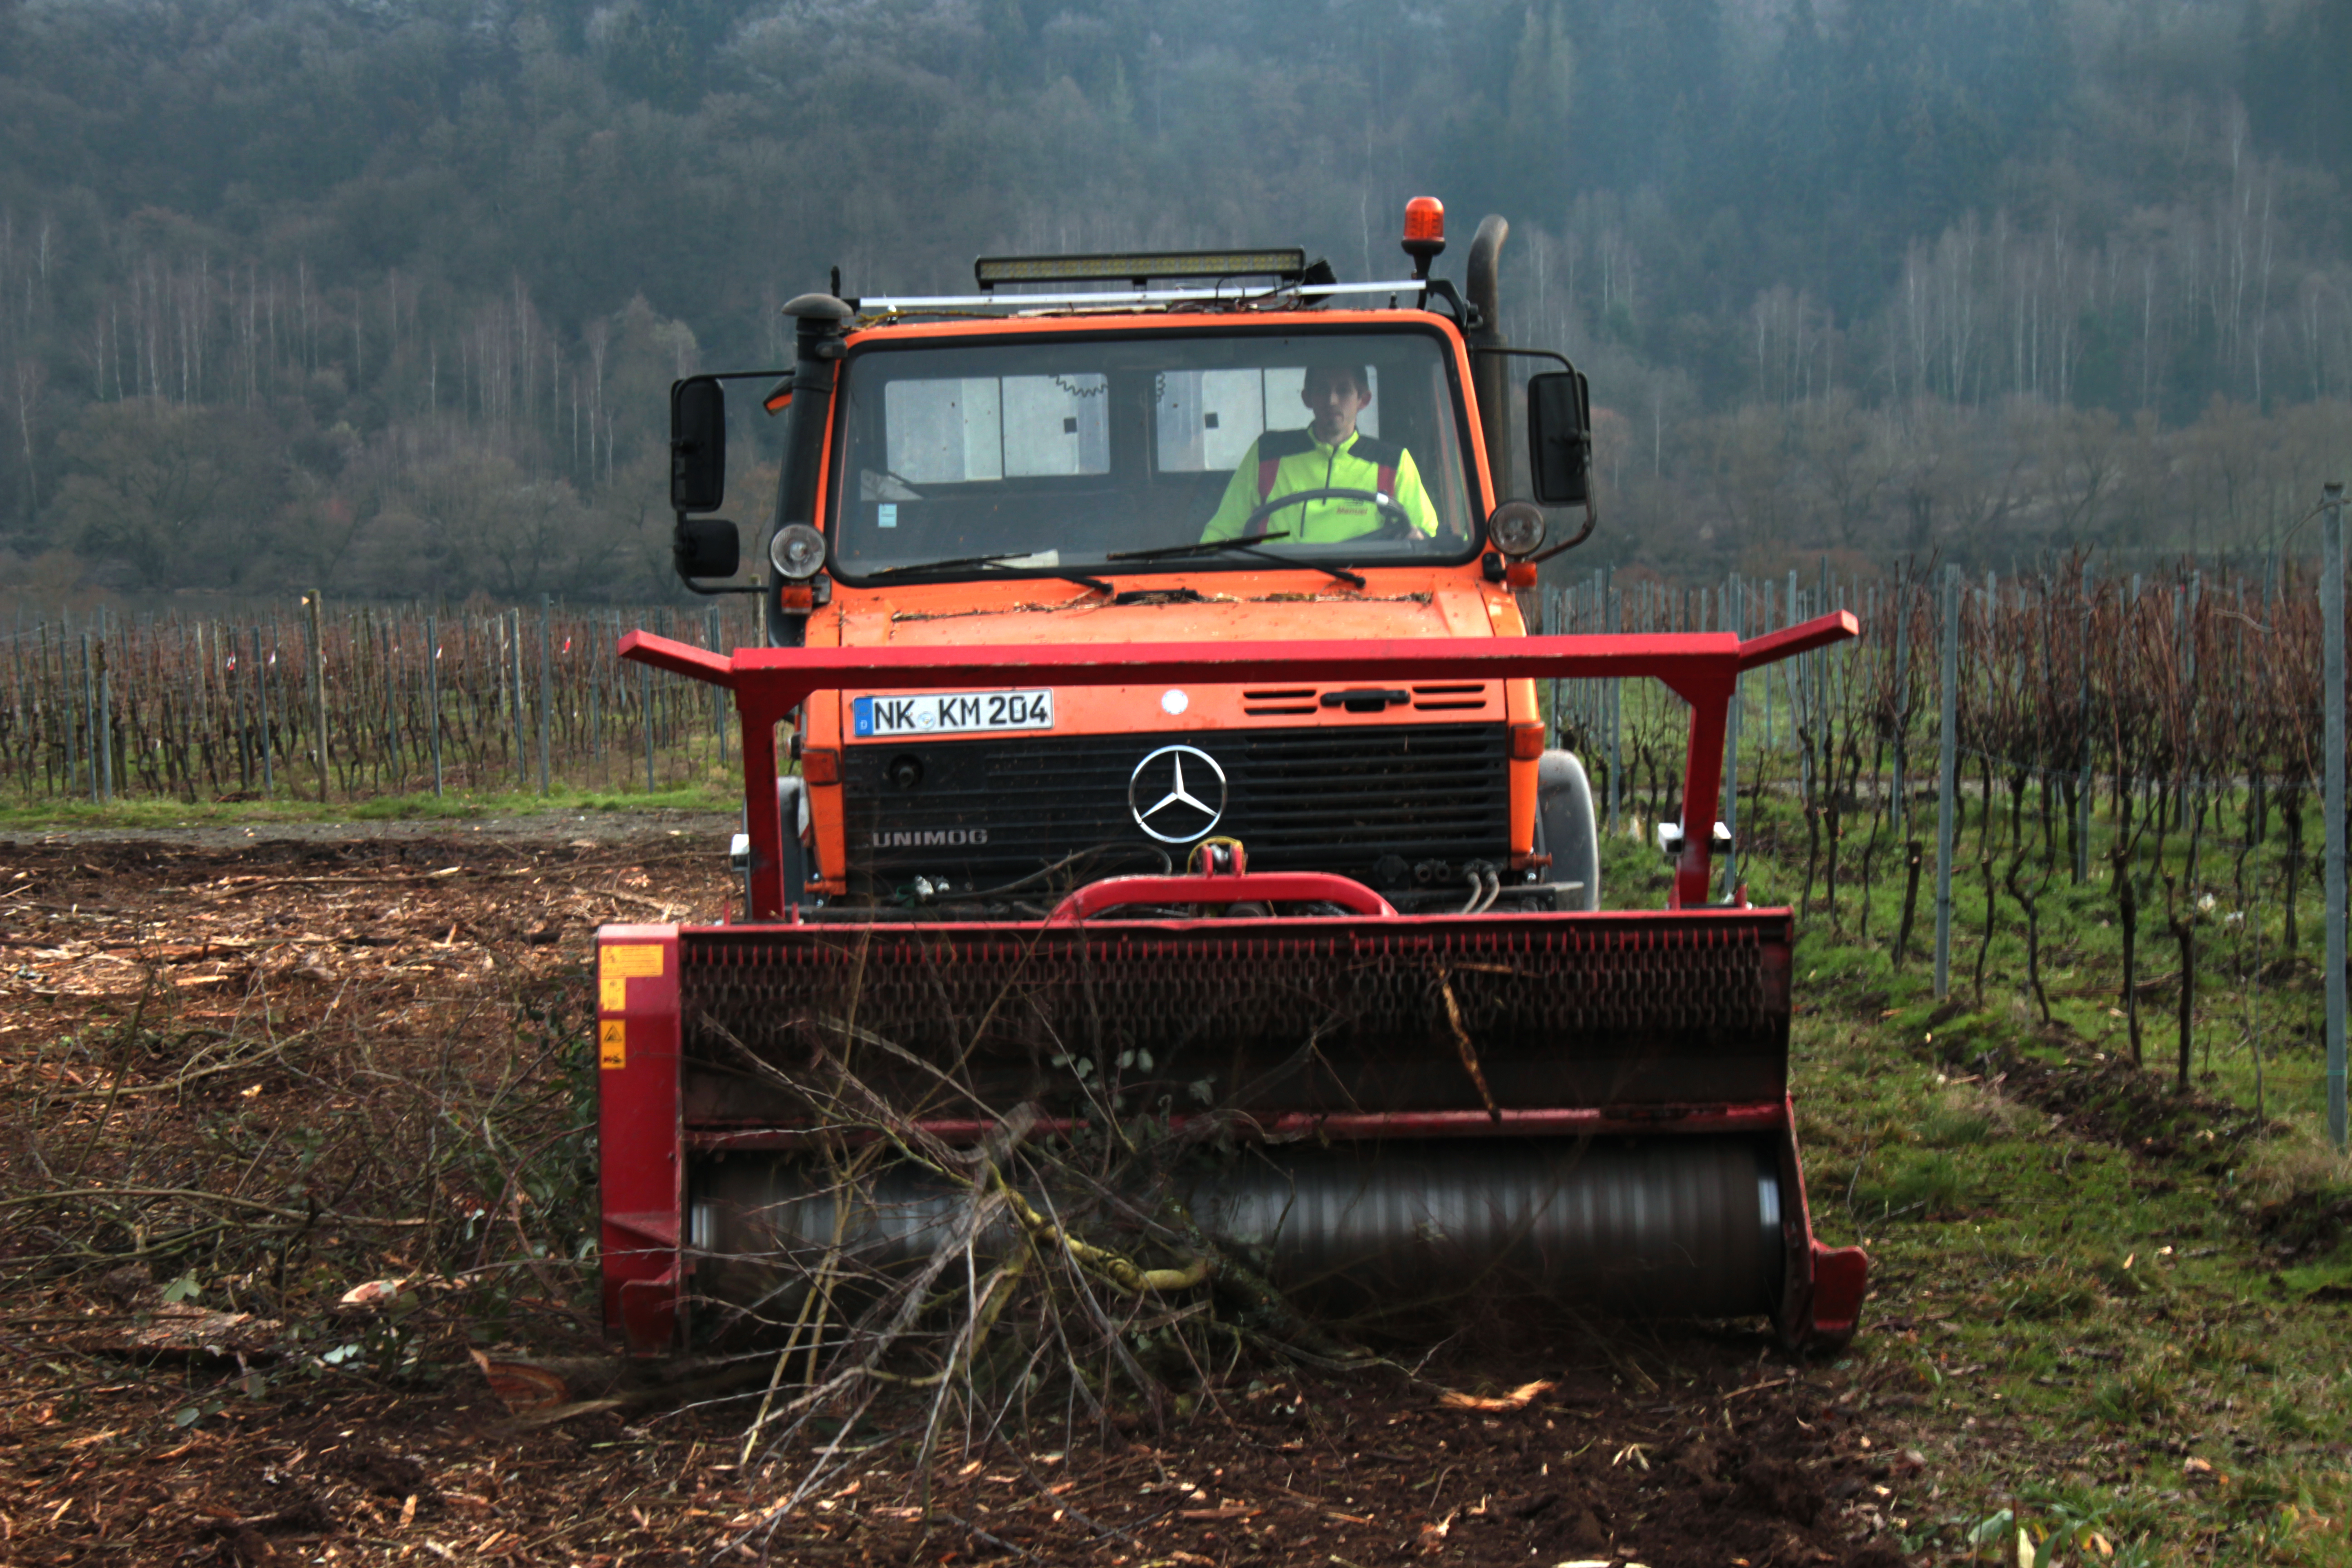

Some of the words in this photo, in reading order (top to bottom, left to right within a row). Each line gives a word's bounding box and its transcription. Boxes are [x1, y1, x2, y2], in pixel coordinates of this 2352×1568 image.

[875, 699, 916, 730] NK
[939, 696, 980, 726] KM
[989, 694, 1048, 724] 204
[860, 720, 867, 730] D
[873, 828, 988, 848] UNIMOG
